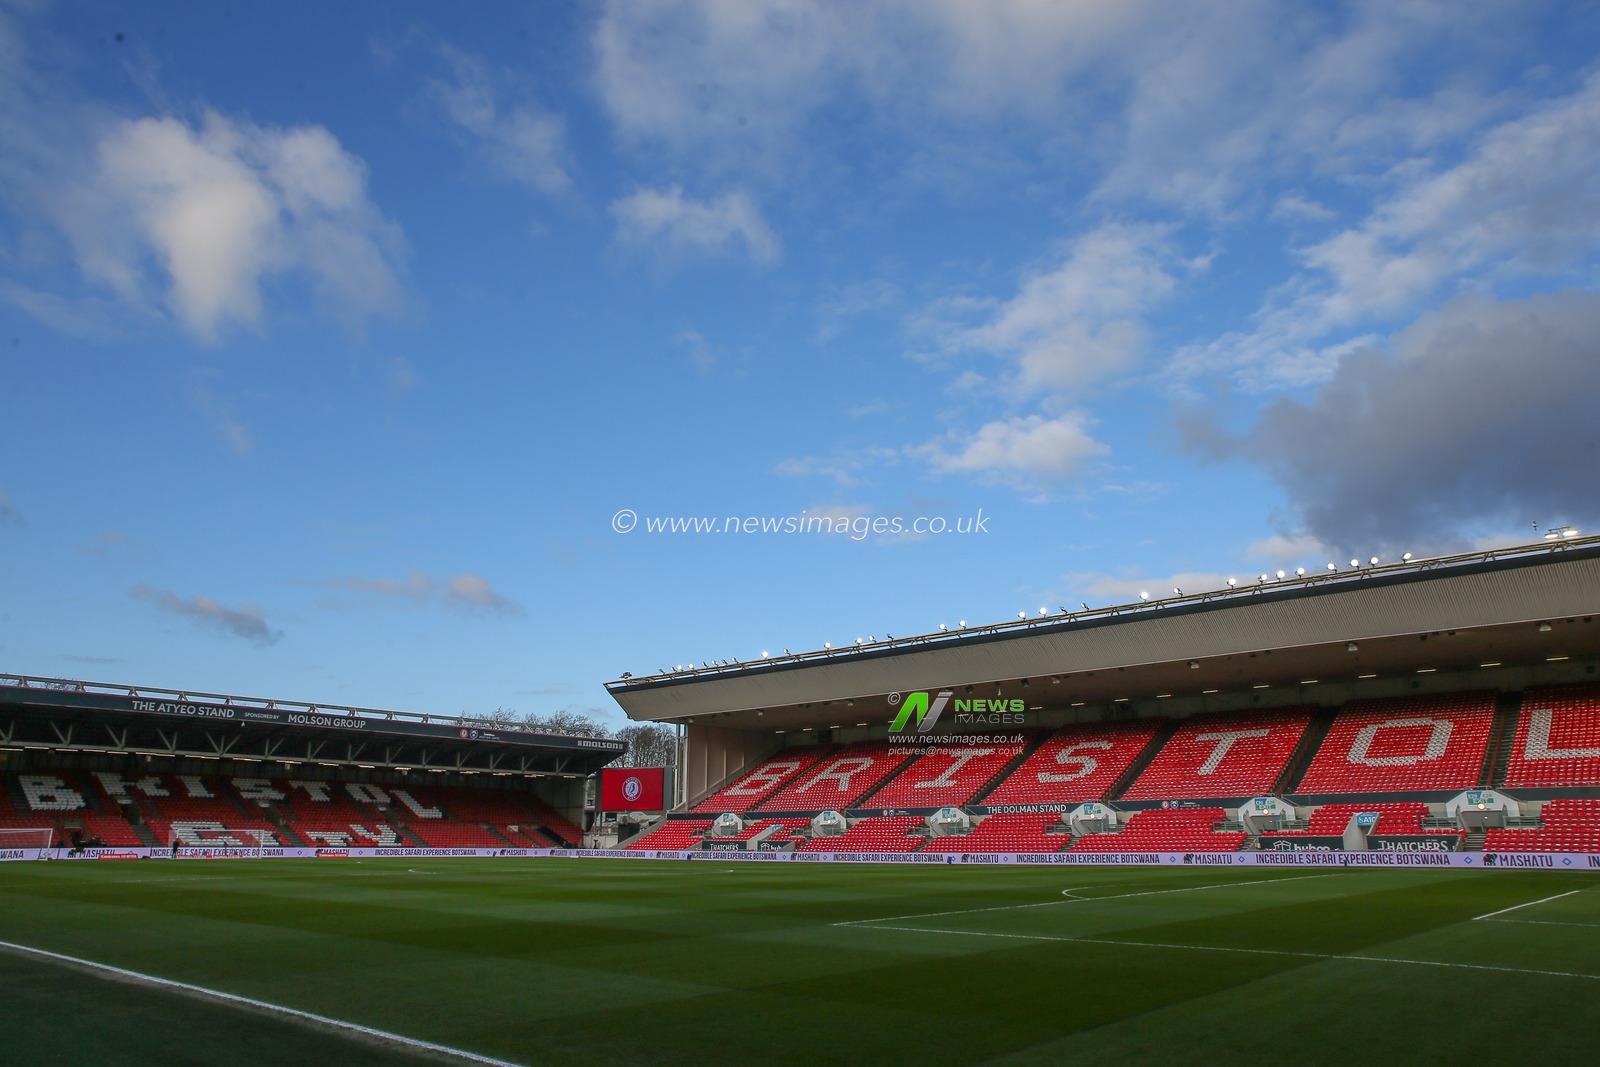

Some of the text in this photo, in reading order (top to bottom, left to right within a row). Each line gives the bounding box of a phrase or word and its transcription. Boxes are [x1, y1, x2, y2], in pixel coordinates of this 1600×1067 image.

[132, 701, 156, 712] THE
[157, 702, 196, 715] ATYEO
[198, 705, 235, 718] STAND
[288, 713, 331, 726] MOLSON
[333, 718, 366, 729] GROUP
[987, 804, 1067, 814] THE DOLMAN STAND
[1378, 840, 1449, 852] THATCHERS
[833, 853, 944, 863] INCREDIBLE SAFARI EXPERIENCE BOTSWANA
[970, 854, 999, 863] MASHATU
[1016, 854, 1160, 864] INCREDIBLE SAFARI EXPERIENCE BOTSWANA
[1195, 854, 1232, 865] MASHATU
[1255, 853, 1450, 865] INCREDIBLE SAFARI EXPERIENCE BOTSWANA
[1499, 854, 1553, 867] MASHATU
